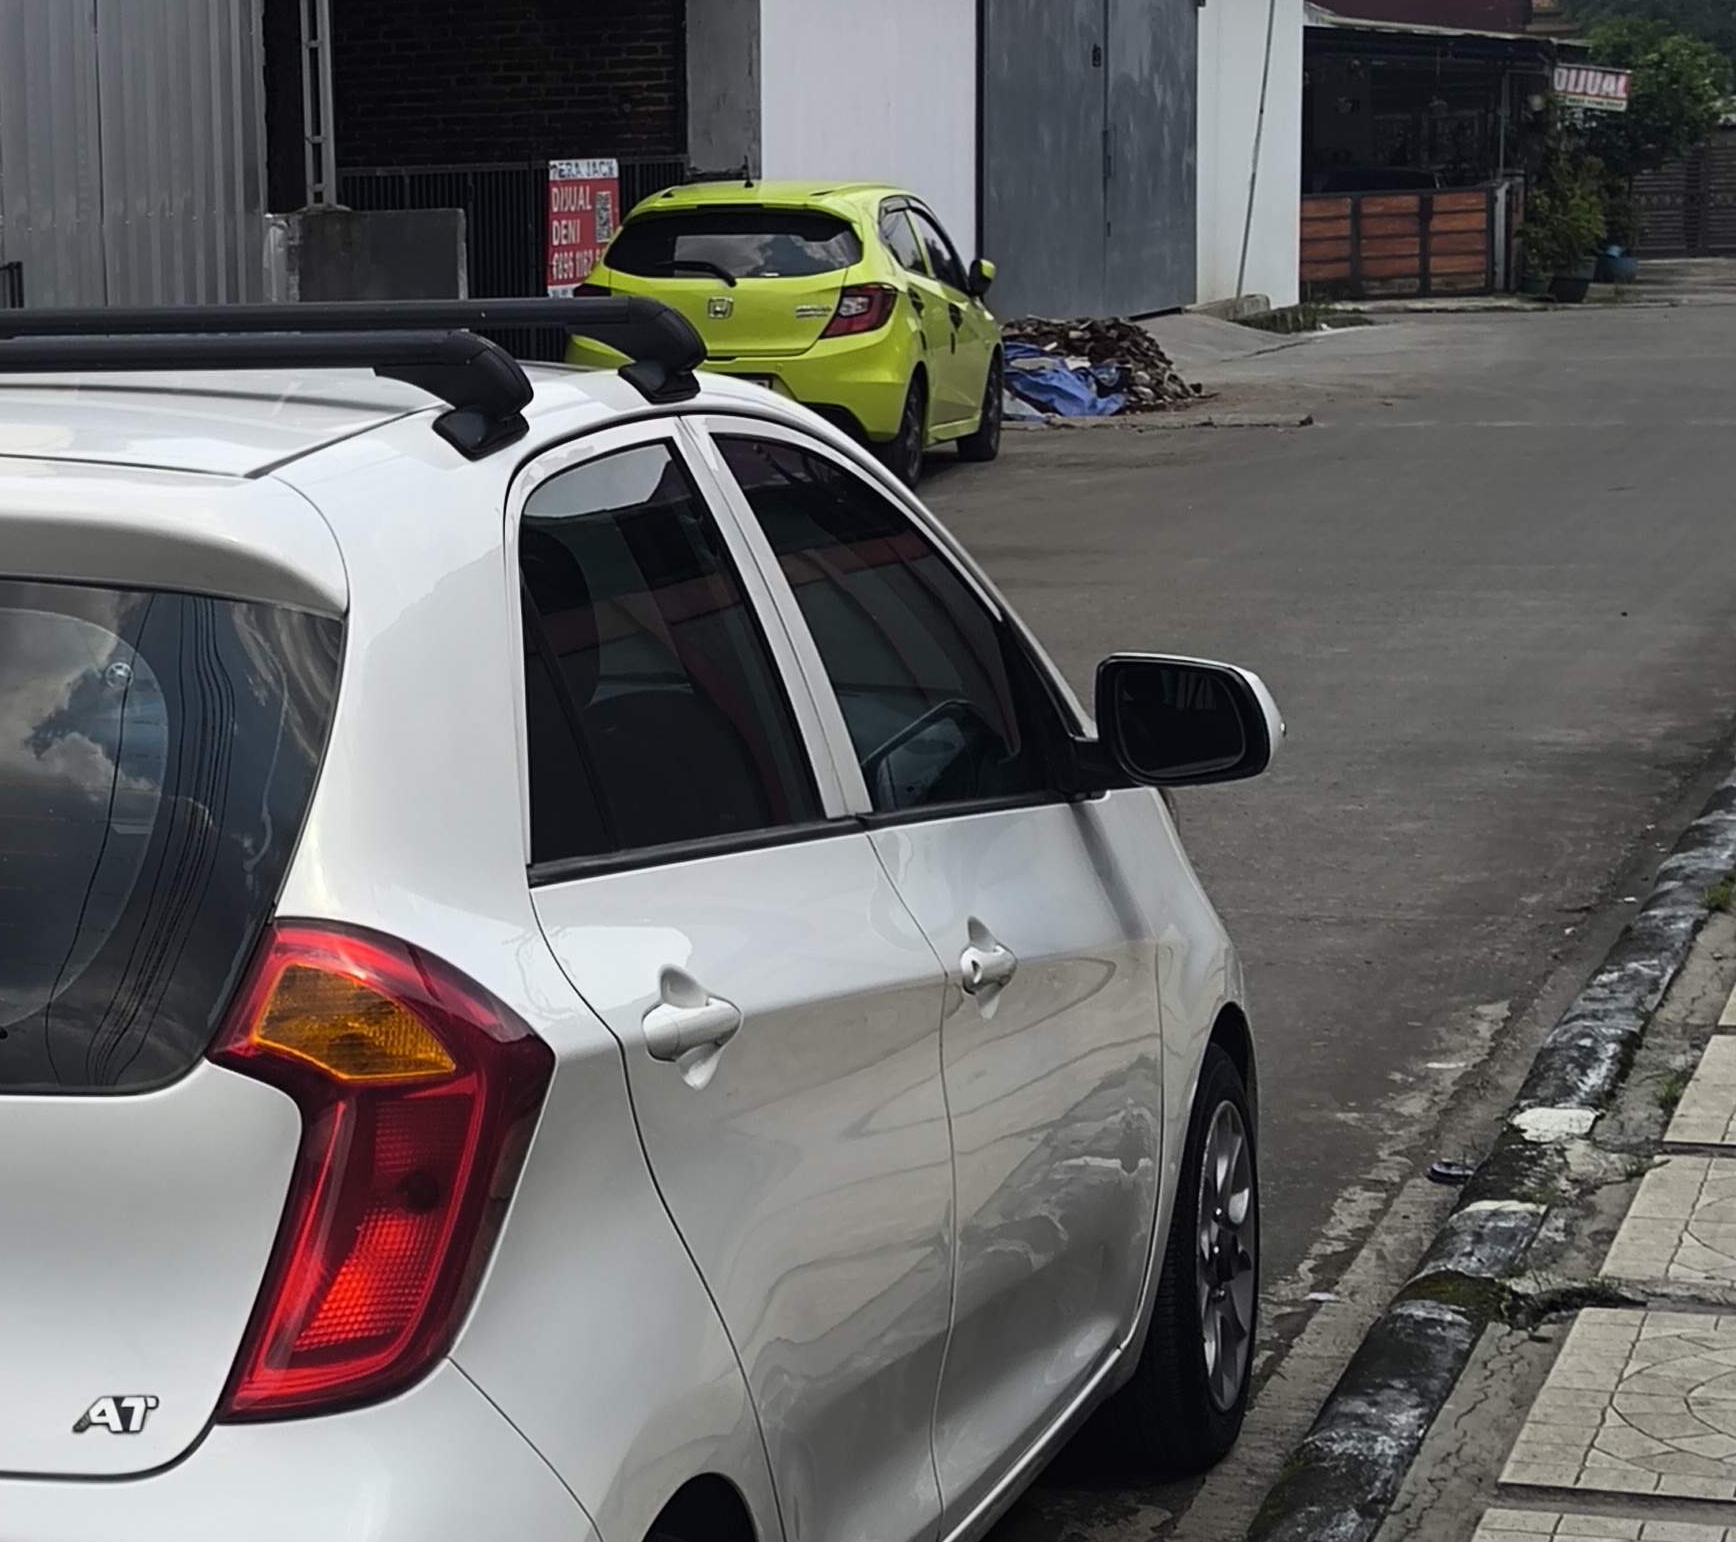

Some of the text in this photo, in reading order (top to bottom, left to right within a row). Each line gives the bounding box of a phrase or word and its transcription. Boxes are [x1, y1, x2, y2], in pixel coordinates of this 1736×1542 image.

[1554, 67, 1627, 99] DIJUAL
[551, 185, 592, 212] DIJUAL
[552, 219, 580, 246] DENI
[72, 1395, 159, 1433] AT
